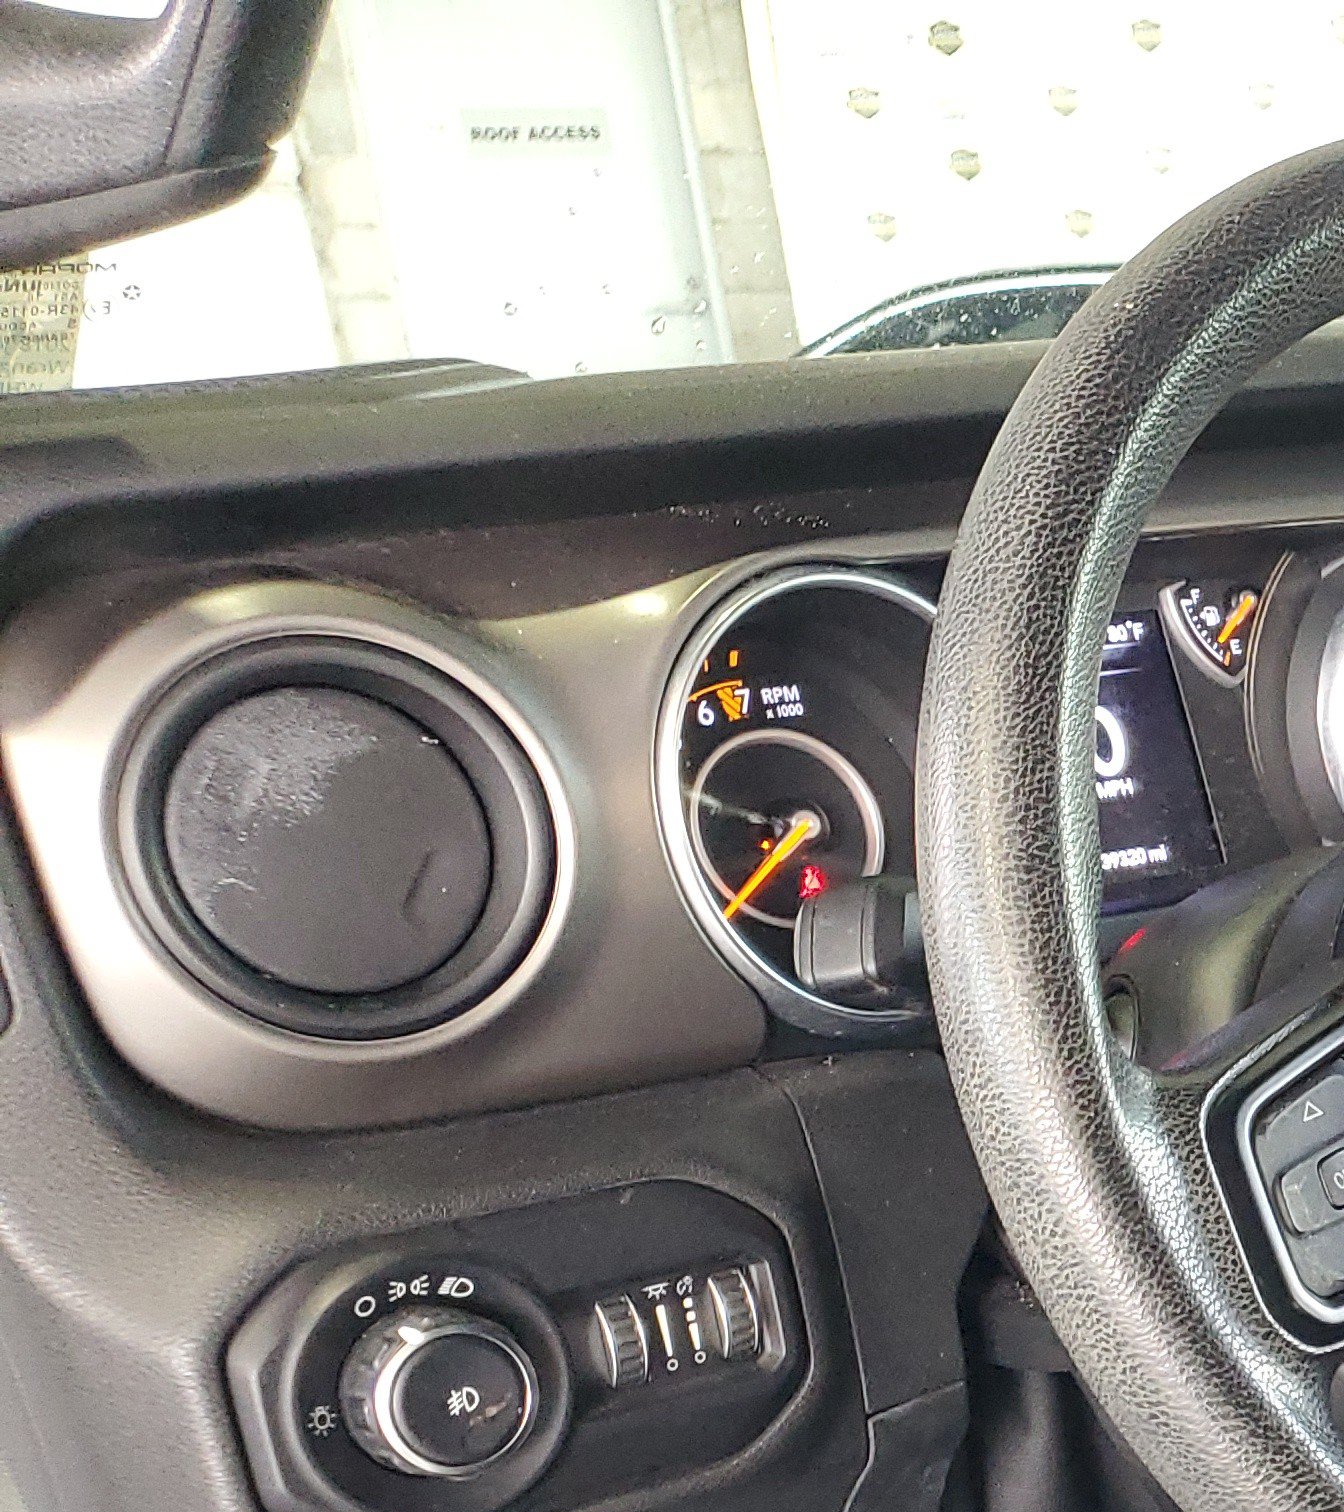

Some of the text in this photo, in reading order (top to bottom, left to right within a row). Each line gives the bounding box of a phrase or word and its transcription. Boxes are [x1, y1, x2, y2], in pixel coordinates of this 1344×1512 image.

[469, 125, 601, 142] ROOF ACCESS
[1190, 588, 1200, 604] F
[1230, 638, 1243, 655] E
[733, 687, 751, 715] 7
[759, 684, 801, 705] RPM
[697, 700, 716, 727] 6
[776, 702, 804, 719] 1000
[1095, 777, 1135, 800] MPH
